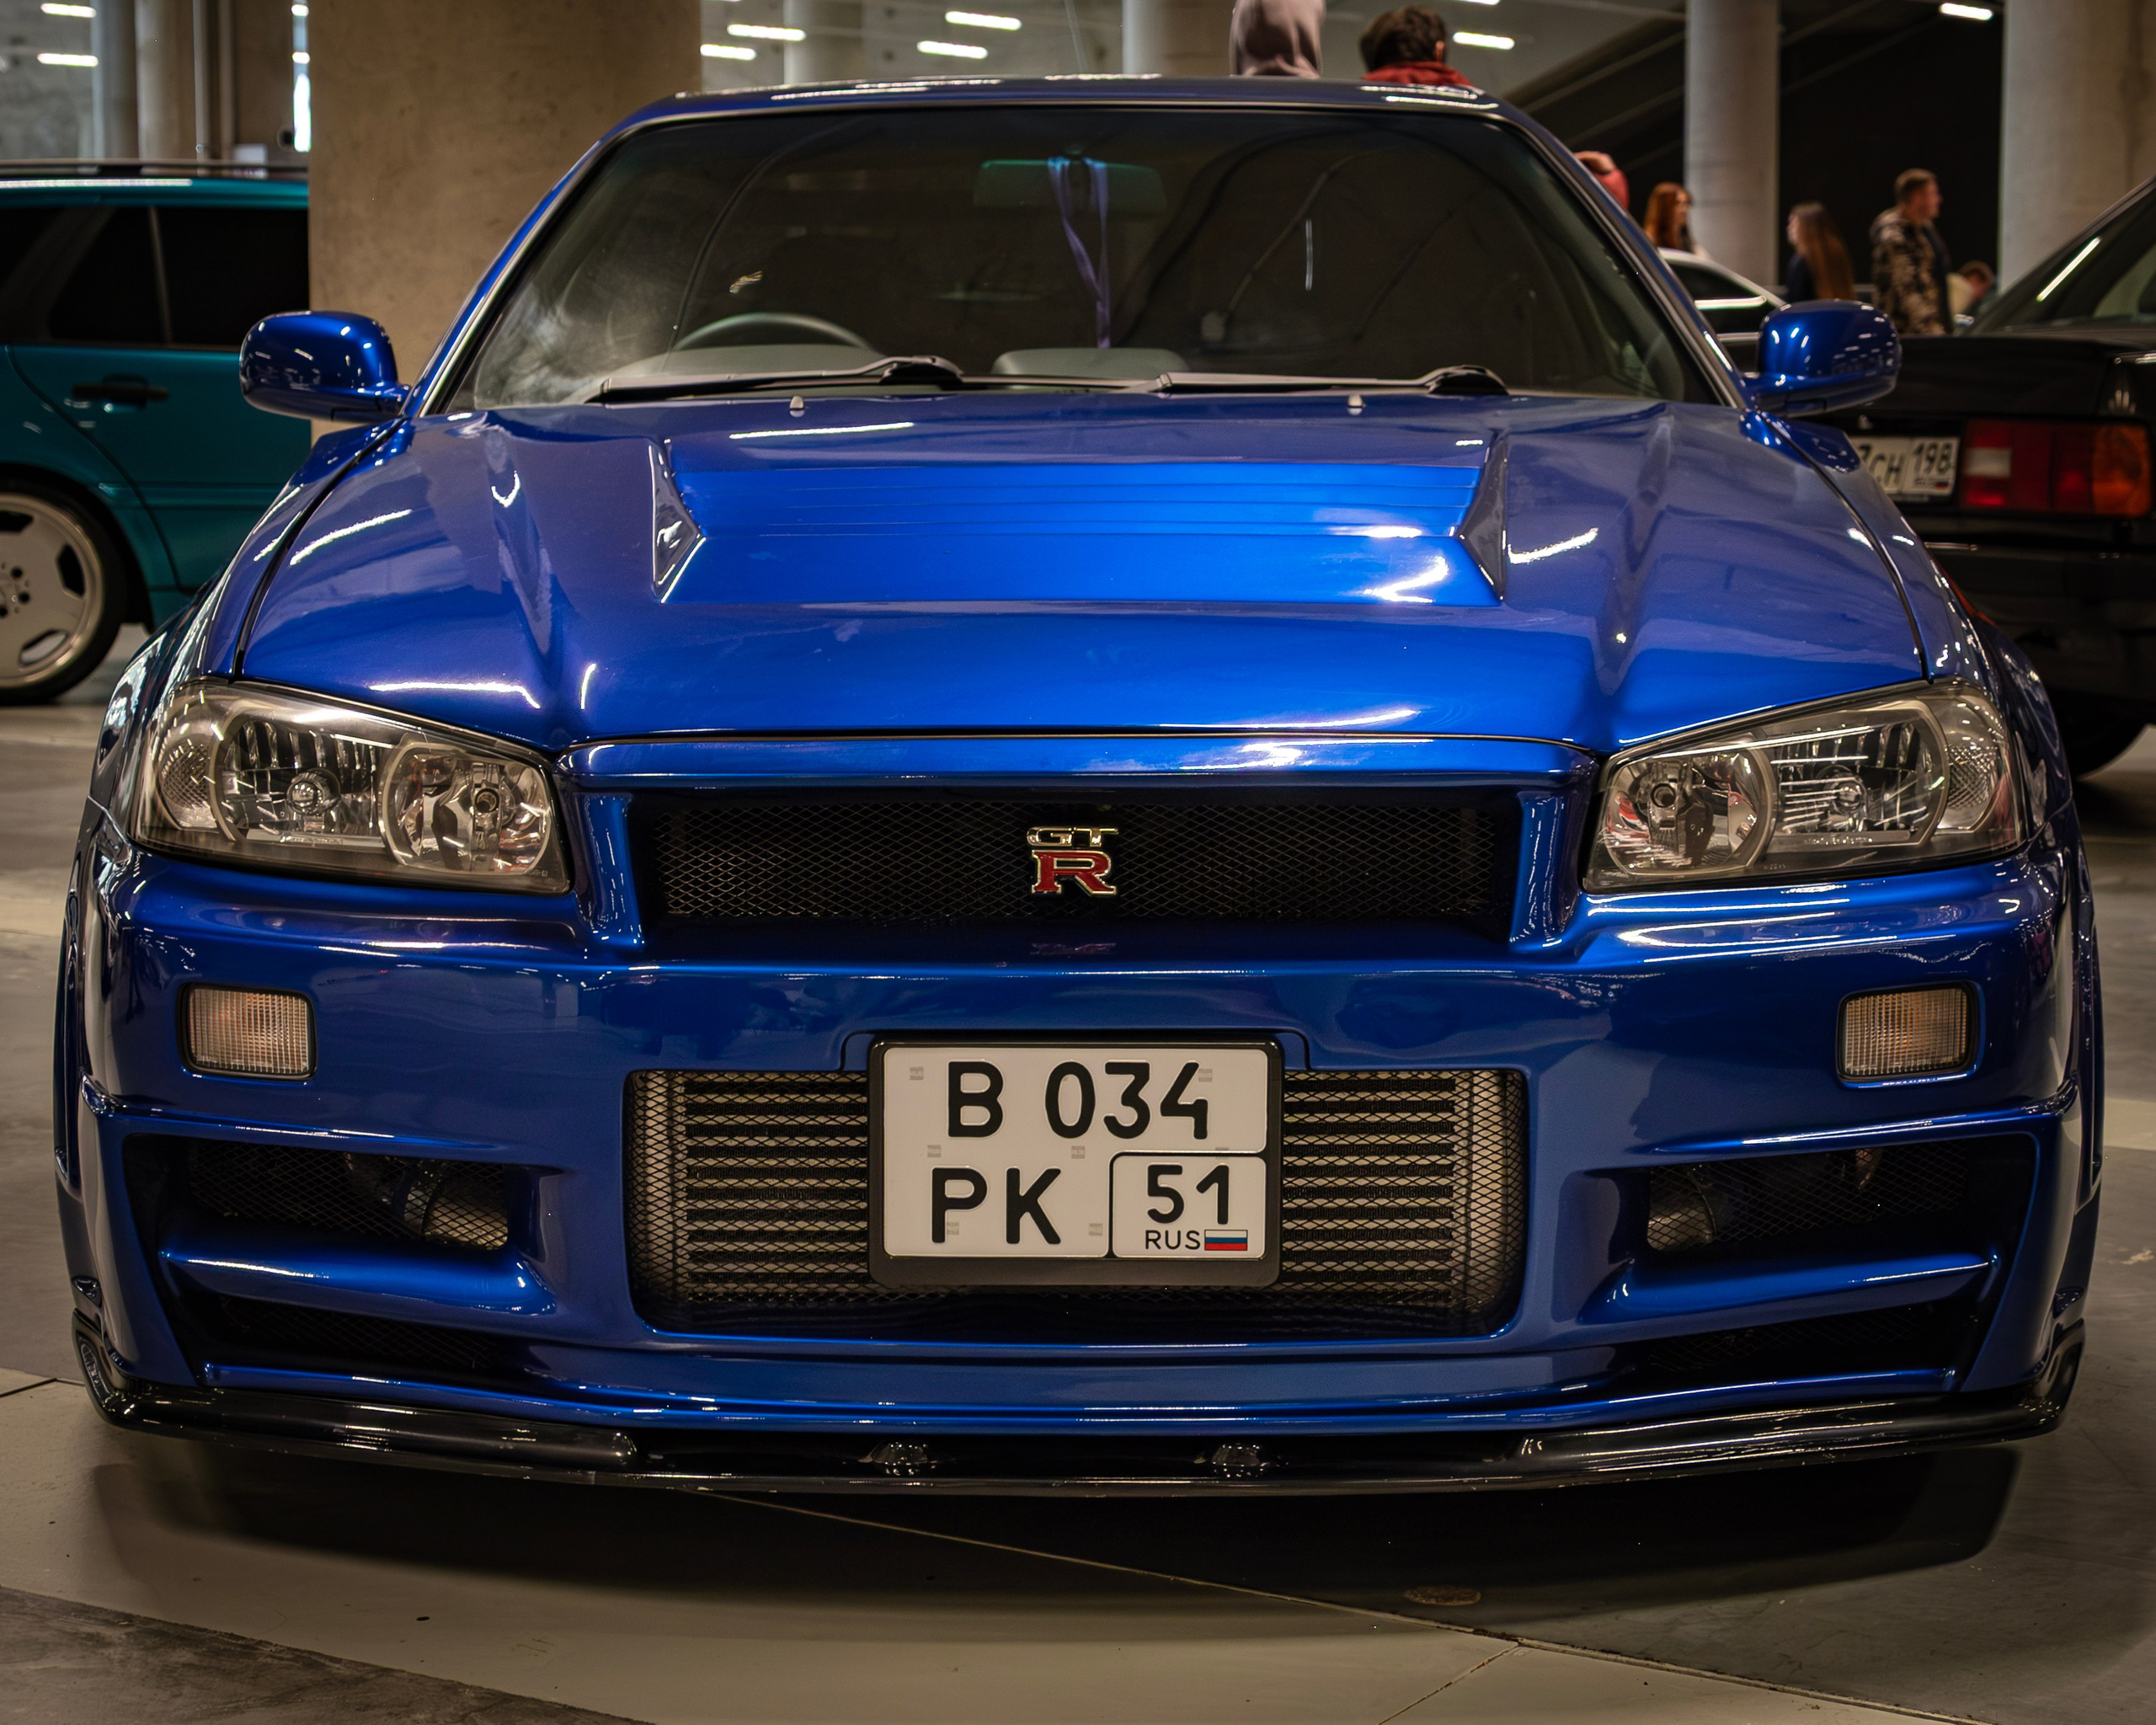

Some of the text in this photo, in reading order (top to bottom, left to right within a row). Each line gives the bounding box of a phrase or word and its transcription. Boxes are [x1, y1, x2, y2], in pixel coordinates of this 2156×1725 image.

[1913, 442, 1951, 475] 198
[1027, 827, 1118, 847] GT
[1032, 850, 1117, 895] R
[948, 1060, 1208, 1140] B 034
[931, 1167, 1062, 1244] PK
[1147, 1164, 1230, 1225] 51
[1145, 1230, 1200, 1250] RUS
